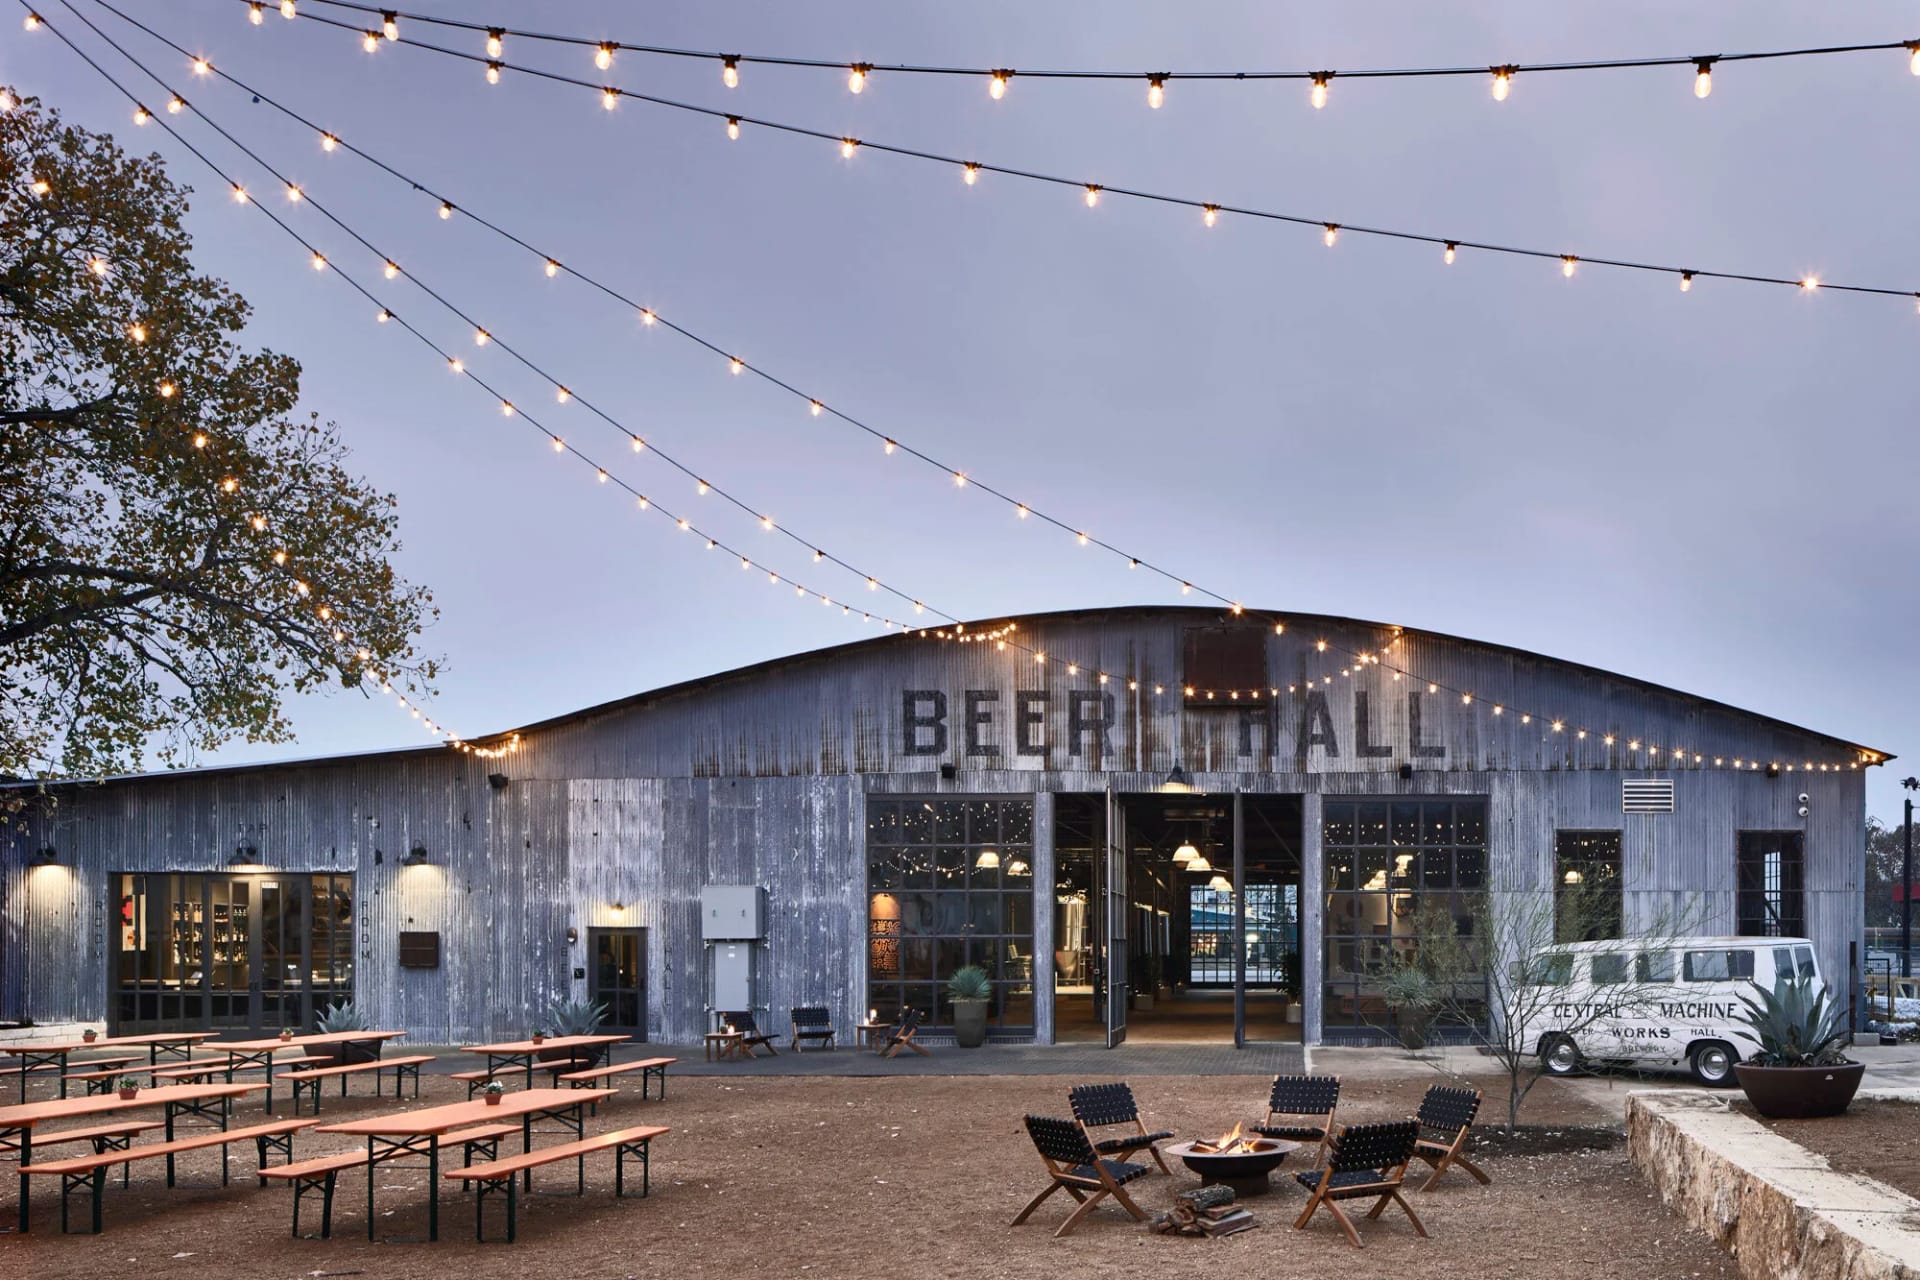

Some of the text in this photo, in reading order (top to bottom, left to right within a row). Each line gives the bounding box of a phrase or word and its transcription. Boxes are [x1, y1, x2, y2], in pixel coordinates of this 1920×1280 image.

[902, 689, 1446, 759] BEER HALL
[1660, 1003, 1738, 1019] MACHINE
[1611, 1027, 1671, 1039] WORKS
[1690, 1028, 1717, 1037] HALL
